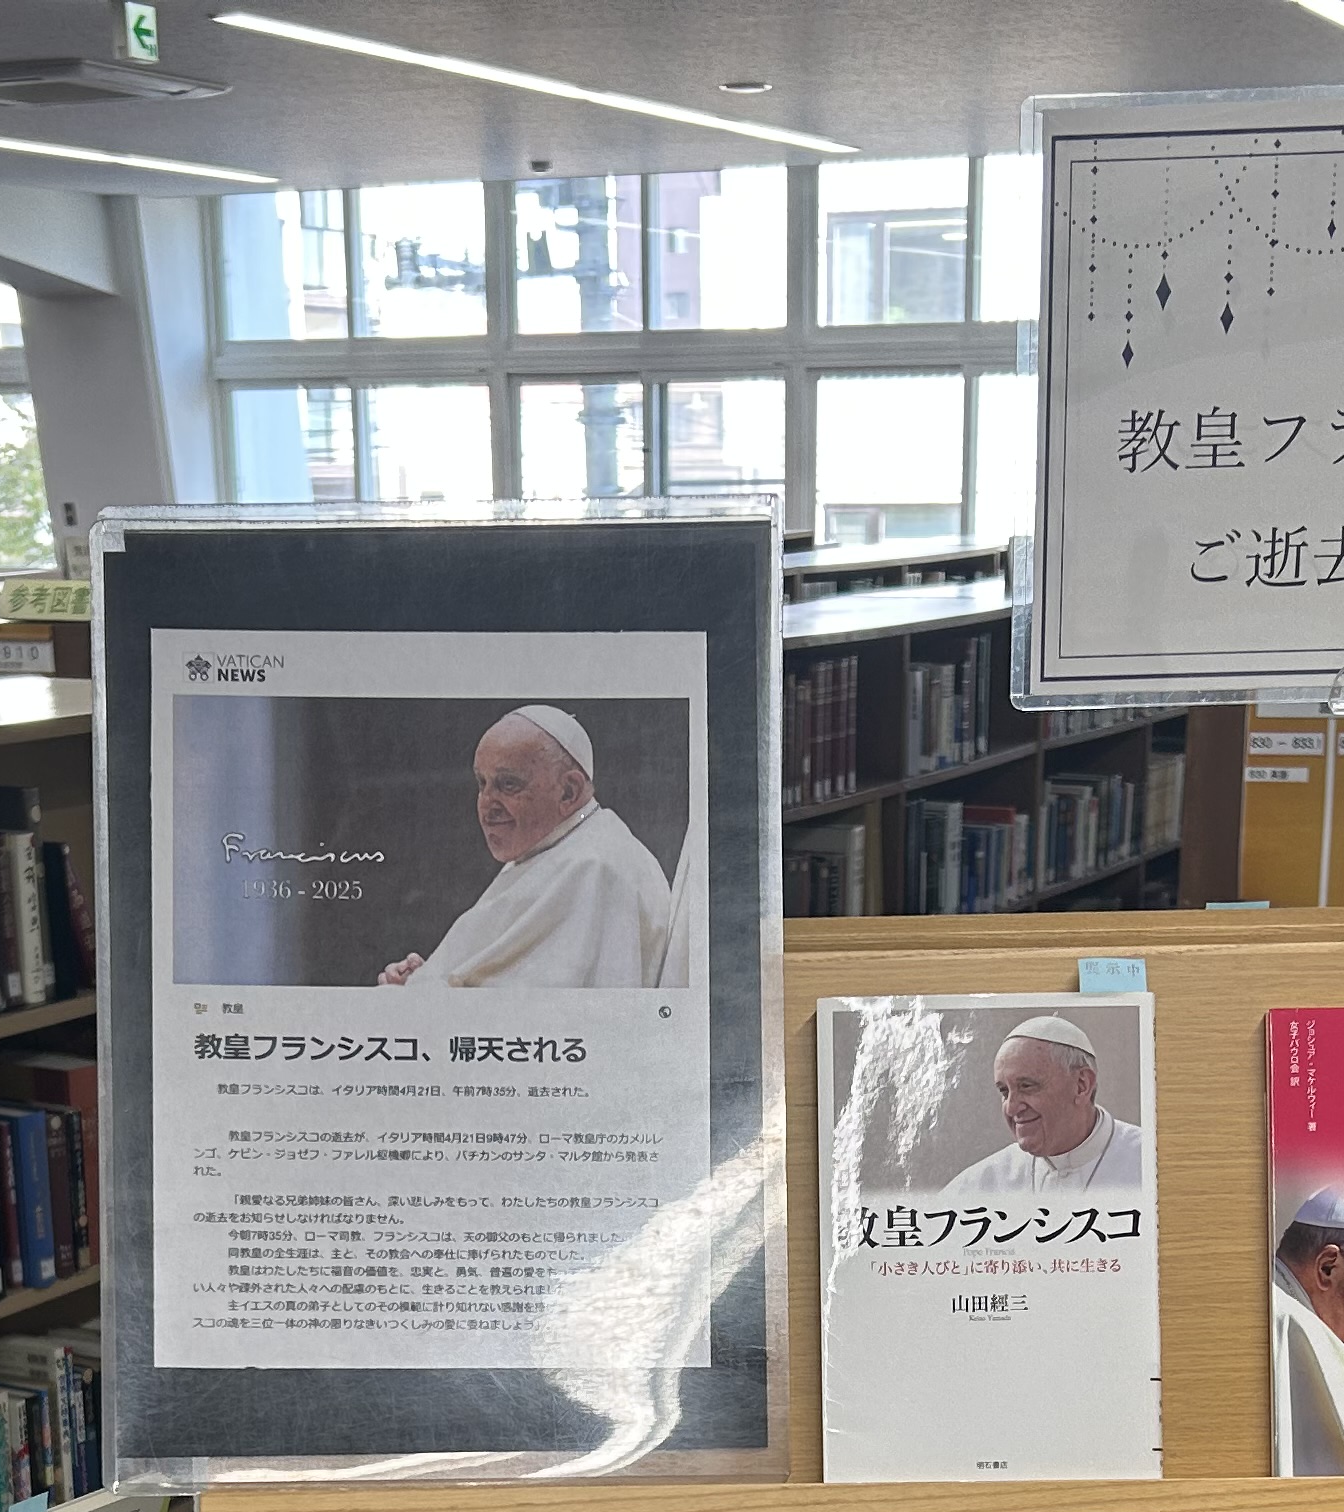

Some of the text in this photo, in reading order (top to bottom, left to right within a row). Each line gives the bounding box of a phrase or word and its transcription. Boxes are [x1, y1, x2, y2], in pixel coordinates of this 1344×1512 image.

[216, 654, 284, 669] VATICAN
[217, 669, 266, 682] NEWS
[312, 880, 364, 900] 2025
[194, 1032, 587, 1064] 教皇フランシスコ、帰天される
[1289, 1020, 1300, 1074] 女子パウロ会
[193, 1166, 222, 1177] れた。
[868, 1257, 1122, 1277] 「小さき人びと」に寄り添い、共に生きる
